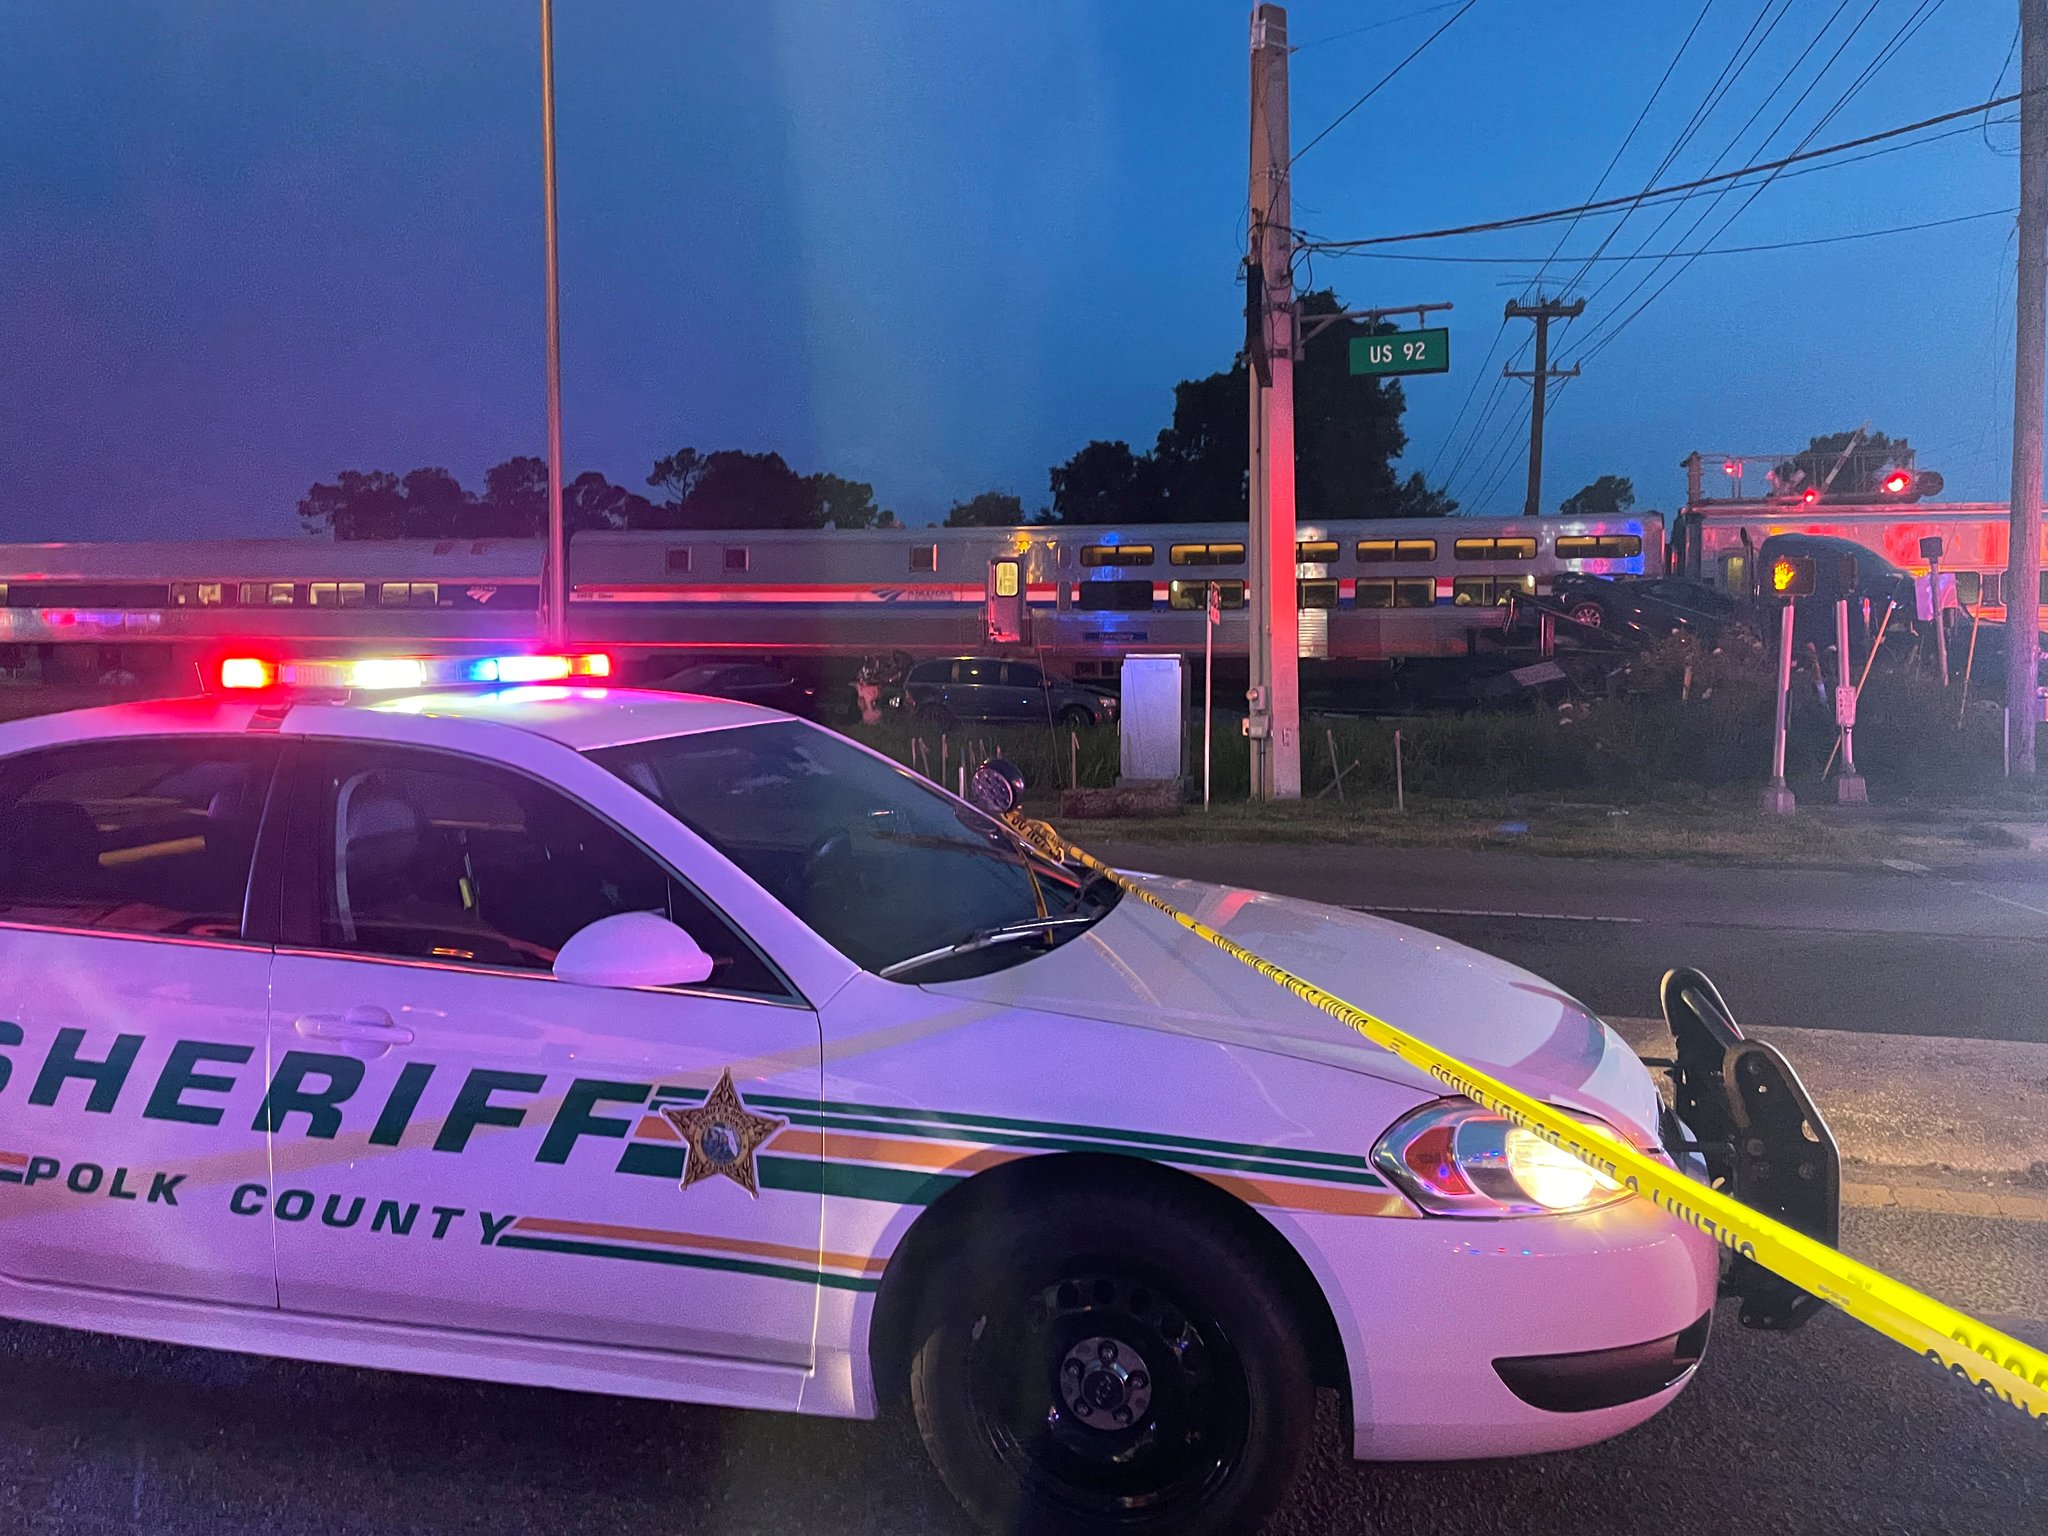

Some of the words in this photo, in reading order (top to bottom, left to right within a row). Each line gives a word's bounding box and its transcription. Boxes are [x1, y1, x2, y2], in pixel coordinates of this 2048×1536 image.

[1369, 344, 1393, 364] US
[1403, 341, 1426, 361] 92
[0, 1020, 653, 1165] HERIFF
[24, 1156, 187, 1206] POLK
[229, 1183, 517, 1246] COUNTY
